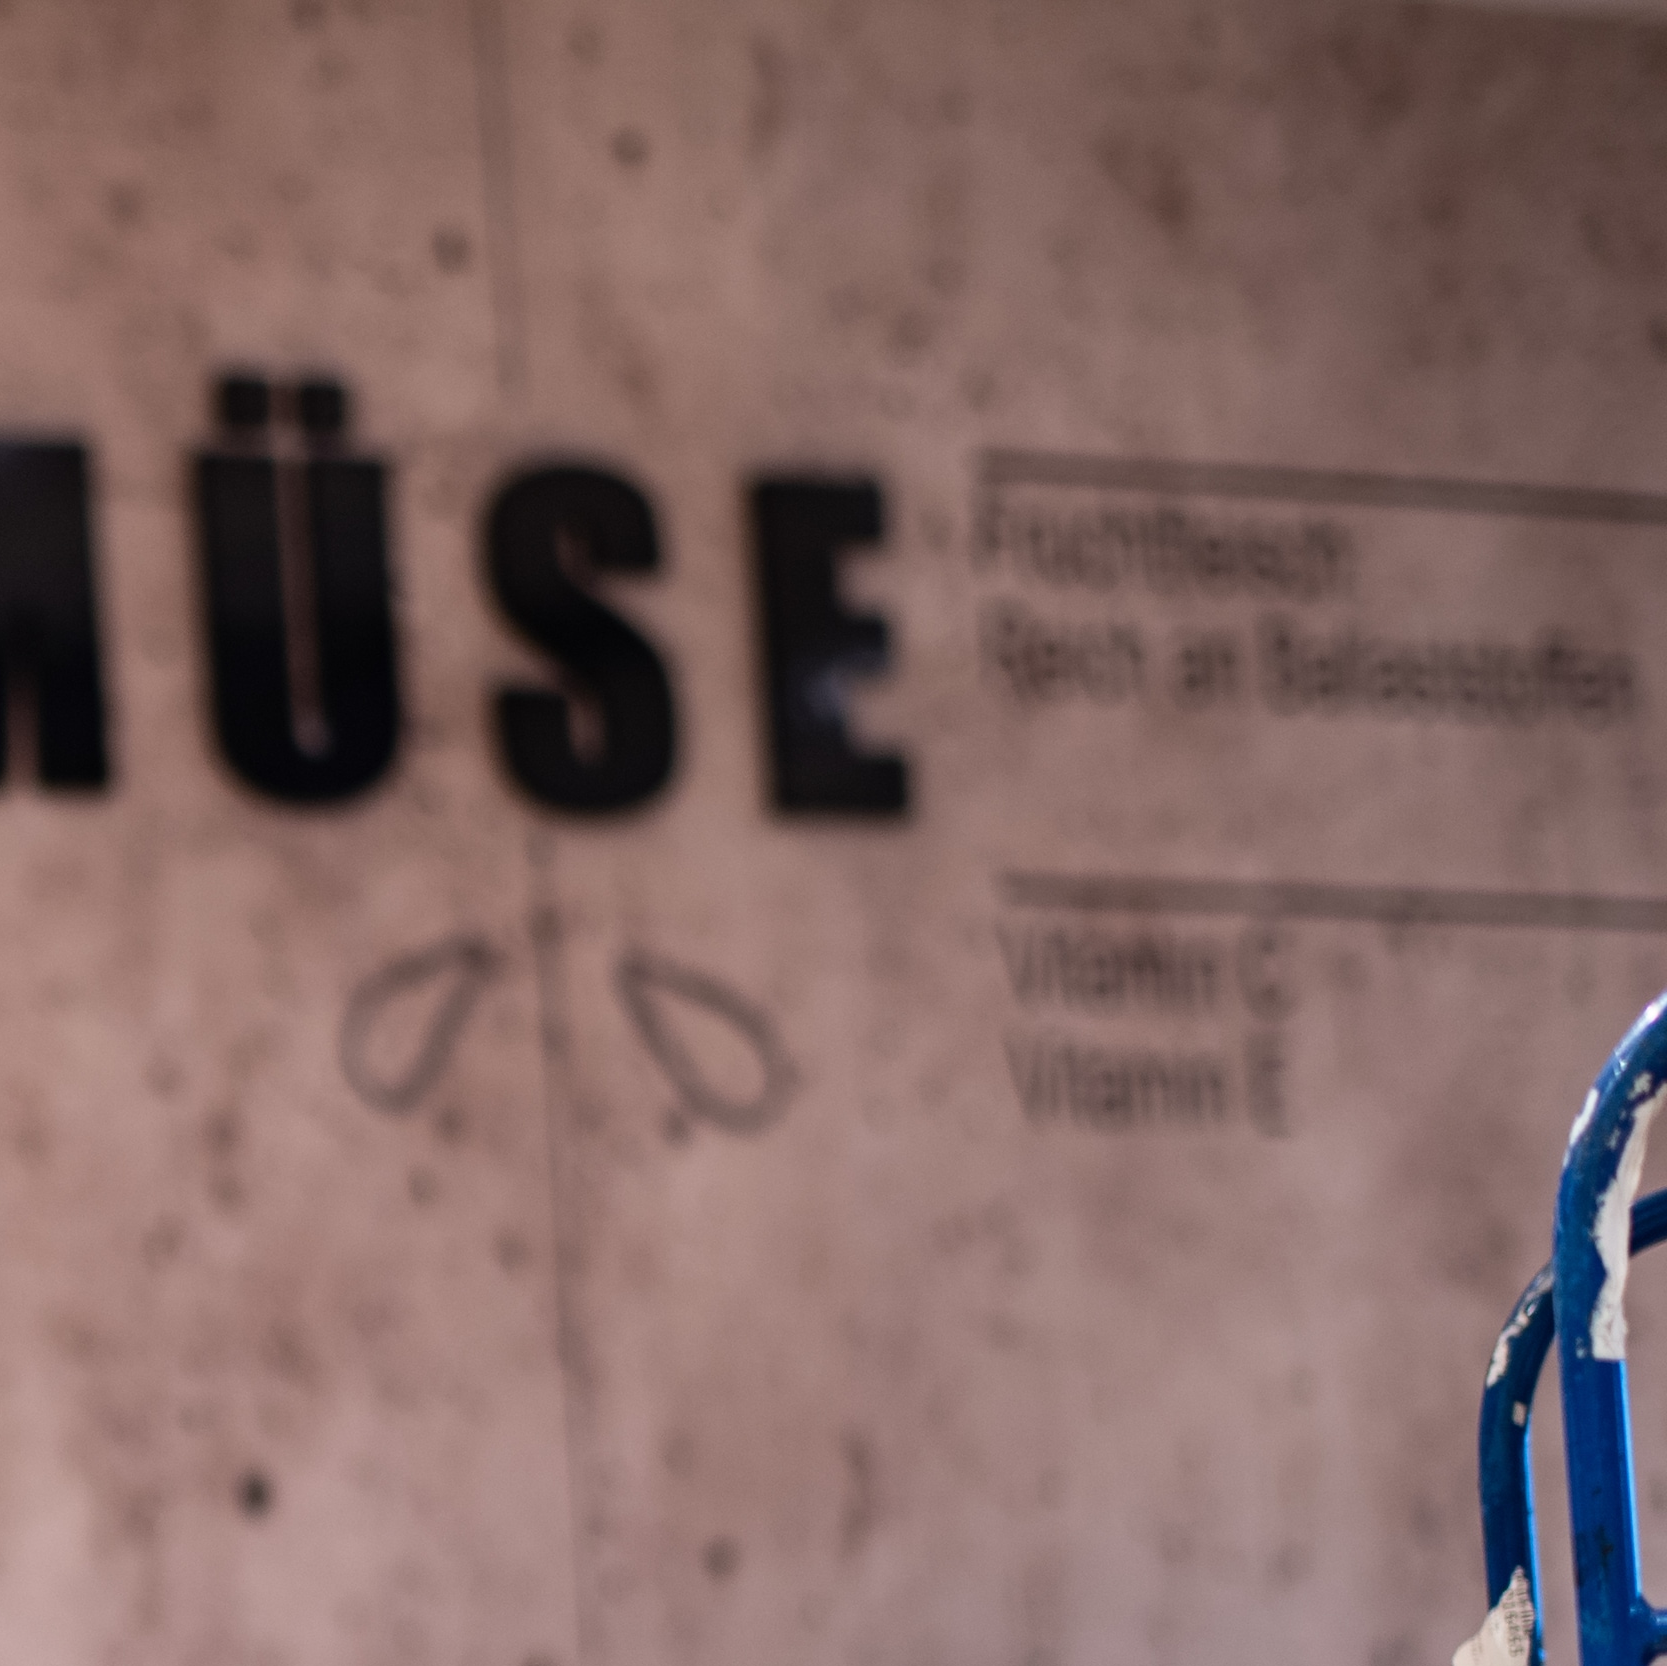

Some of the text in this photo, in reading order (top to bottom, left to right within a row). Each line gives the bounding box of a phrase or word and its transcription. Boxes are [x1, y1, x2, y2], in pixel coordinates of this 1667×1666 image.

[1175, 630, 1243, 706] an
[995, 920, 1296, 1022] Vitamin C
[1002, 1028, 1289, 1138] Vitamin E
